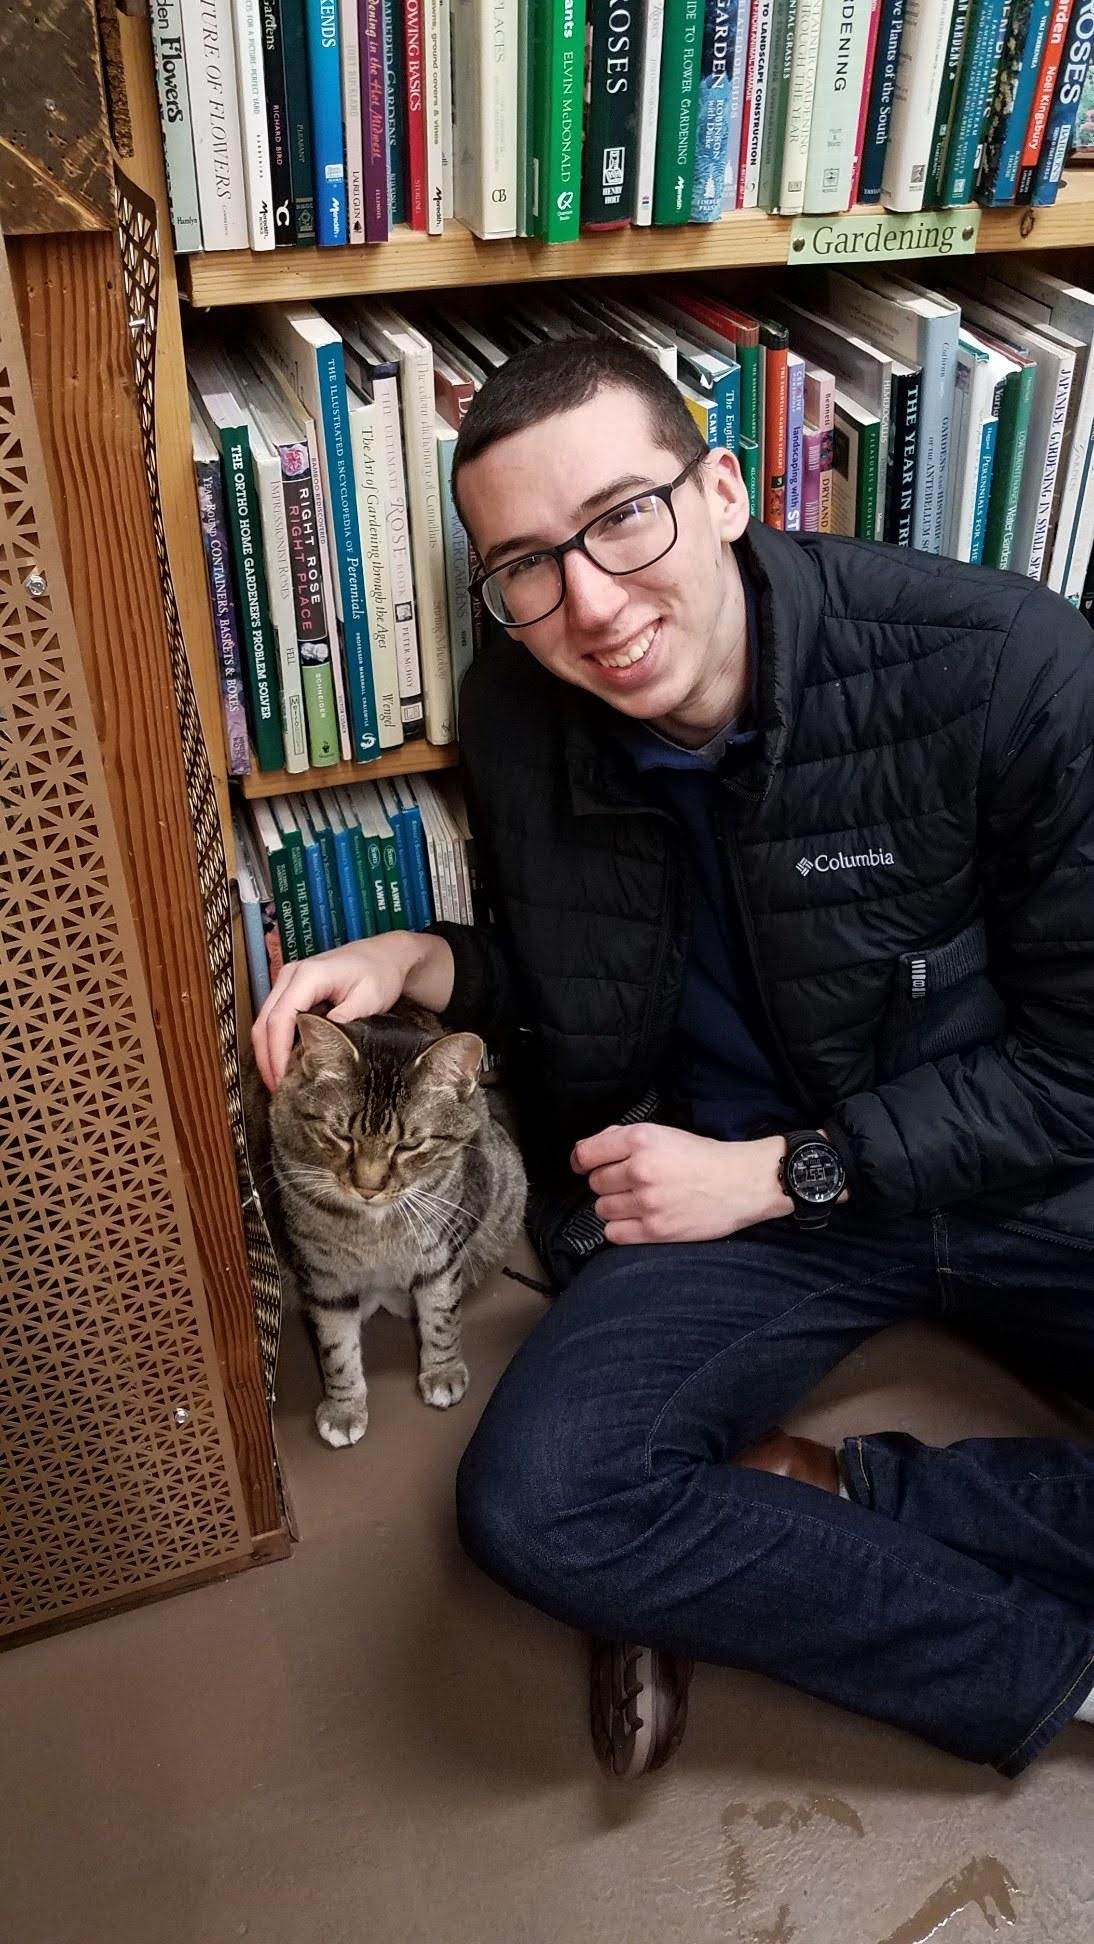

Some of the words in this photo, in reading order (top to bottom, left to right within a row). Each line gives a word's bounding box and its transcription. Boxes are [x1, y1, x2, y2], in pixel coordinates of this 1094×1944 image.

[762, 3, 770, 17] TO
[369, 41, 380, 53] in
[431, 34, 439, 69] ground
[684, 25, 696, 43] TO
[756, 21, 768, 84] LANDSCAPE
[834, 0, 855, 91] DENING
[886, 20, 904, 61] Plants
[949, 16, 967, 67] GARDENS
[369, 58, 383, 75] the
[562, 51, 574, 94] ELVIN
[681, 48, 695, 94] FLOWER
[783, 32, 794, 79] GRASSES
[884, 64, 896, 78] of
[160, 35, 184, 123] Flowers
[206, 65, 223, 95] OF
[408, 61, 421, 111] BASICS
[881, 81, 895, 103] the
[273, 105, 282, 143] RICHARD
[561, 100, 574, 183] McDONALD
[677, 98, 692, 165] GARDENING
[711, 100, 725, 160] ROBINSON
[750, 88, 763, 166] CONSTRUCTION
[789, 107, 802, 143] YEAR
[875, 106, 892, 145] South
[1029, 95, 1050, 150] Kingsbury
[208, 100, 232, 200] FLOWERS
[275, 146, 283, 166] BIRD
[812, 222, 957, 255] Gardening
[327, 358, 338, 381] THE
[725, 390, 735, 412] The
[823, 392, 833, 427] Bennett
[905, 385, 919, 426] THE
[1051, 368, 1072, 428] JAPANESE
[330, 384, 344, 457] ILLUSTRATED
[361, 425, 374, 451] The
[707, 412, 718, 444] CAN'T
[231, 445, 244, 470] THE
[789, 426, 801, 485] landscaping
[867, 433, 876, 483] PLEASURES
[902, 431, 917, 485] YEAR
[939, 416, 950, 473] GARDENS
[1042, 431, 1062, 498] GARDENING
[311, 457, 320, 491] BAMBOO
[362, 453, 376, 477] Art
[977, 455, 993, 515] PERENNIALS
[234, 475, 249, 516] ORTHO
[337, 459, 351, 538] ENCYCLOPEDIA
[361, 478, 377, 493] of
[791, 487, 801, 508] with
[821, 477, 830, 528] DRYLAND
[900, 490, 912, 510] IN
[922, 463, 935, 541] ANTEBELLUM
[300, 487, 315, 545] RIGHT
[315, 493, 326, 545] REDISCOVERED
[366, 494, 380, 559] Gardening
[385, 497, 408, 558] ROSE
[864, 496, 873, 540] PROBLEM
[934, 491, 945, 540] HISTORIC
[974, 517, 983, 538] FOR
[1004, 505, 1017, 531] Water
[1039, 501, 1051, 514] IN
[239, 519, 253, 555] HOME
[346, 541, 354, 554] OF
[971, 541, 980, 562] THE
[999, 532, 1014, 570] Gardens
[1032, 518, 1049, 554] SMALL
[210, 540, 229, 616] CONTAINERS,
[289, 505, 305, 562] RIGHT
[297, 573, 312, 631] PLACE
[307, 556, 321, 604] ROSE
[369, 559, 387, 603] through
[243, 558, 262, 628] GARDENER'S
[346, 556, 365, 621] Perennials
[375, 604, 388, 624] the
[219, 619, 235, 666] BASKETS
[252, 631, 267, 680] PROBLEM
[355, 632, 364, 667] PROFESSOR
[374, 624, 388, 649] Ages
[402, 626, 411, 654] PETER
[224, 668, 233, 676] &
[358, 668, 367, 696] MARSHALL
[226, 680, 240, 712] BOXES
[258, 682, 272, 720] SOLVER
[315, 672, 326, 719] SCHNEIDER
[380, 693, 396, 729] Wengel
[814, 848, 896, 873] Columbia
[296, 880, 308, 902] THE
[374, 879, 387, 911] LAWNS
[390, 881, 402, 913] LAWNS
[281, 900, 298, 949] GROWING
[299, 902, 316, 956] PRACTICAL
